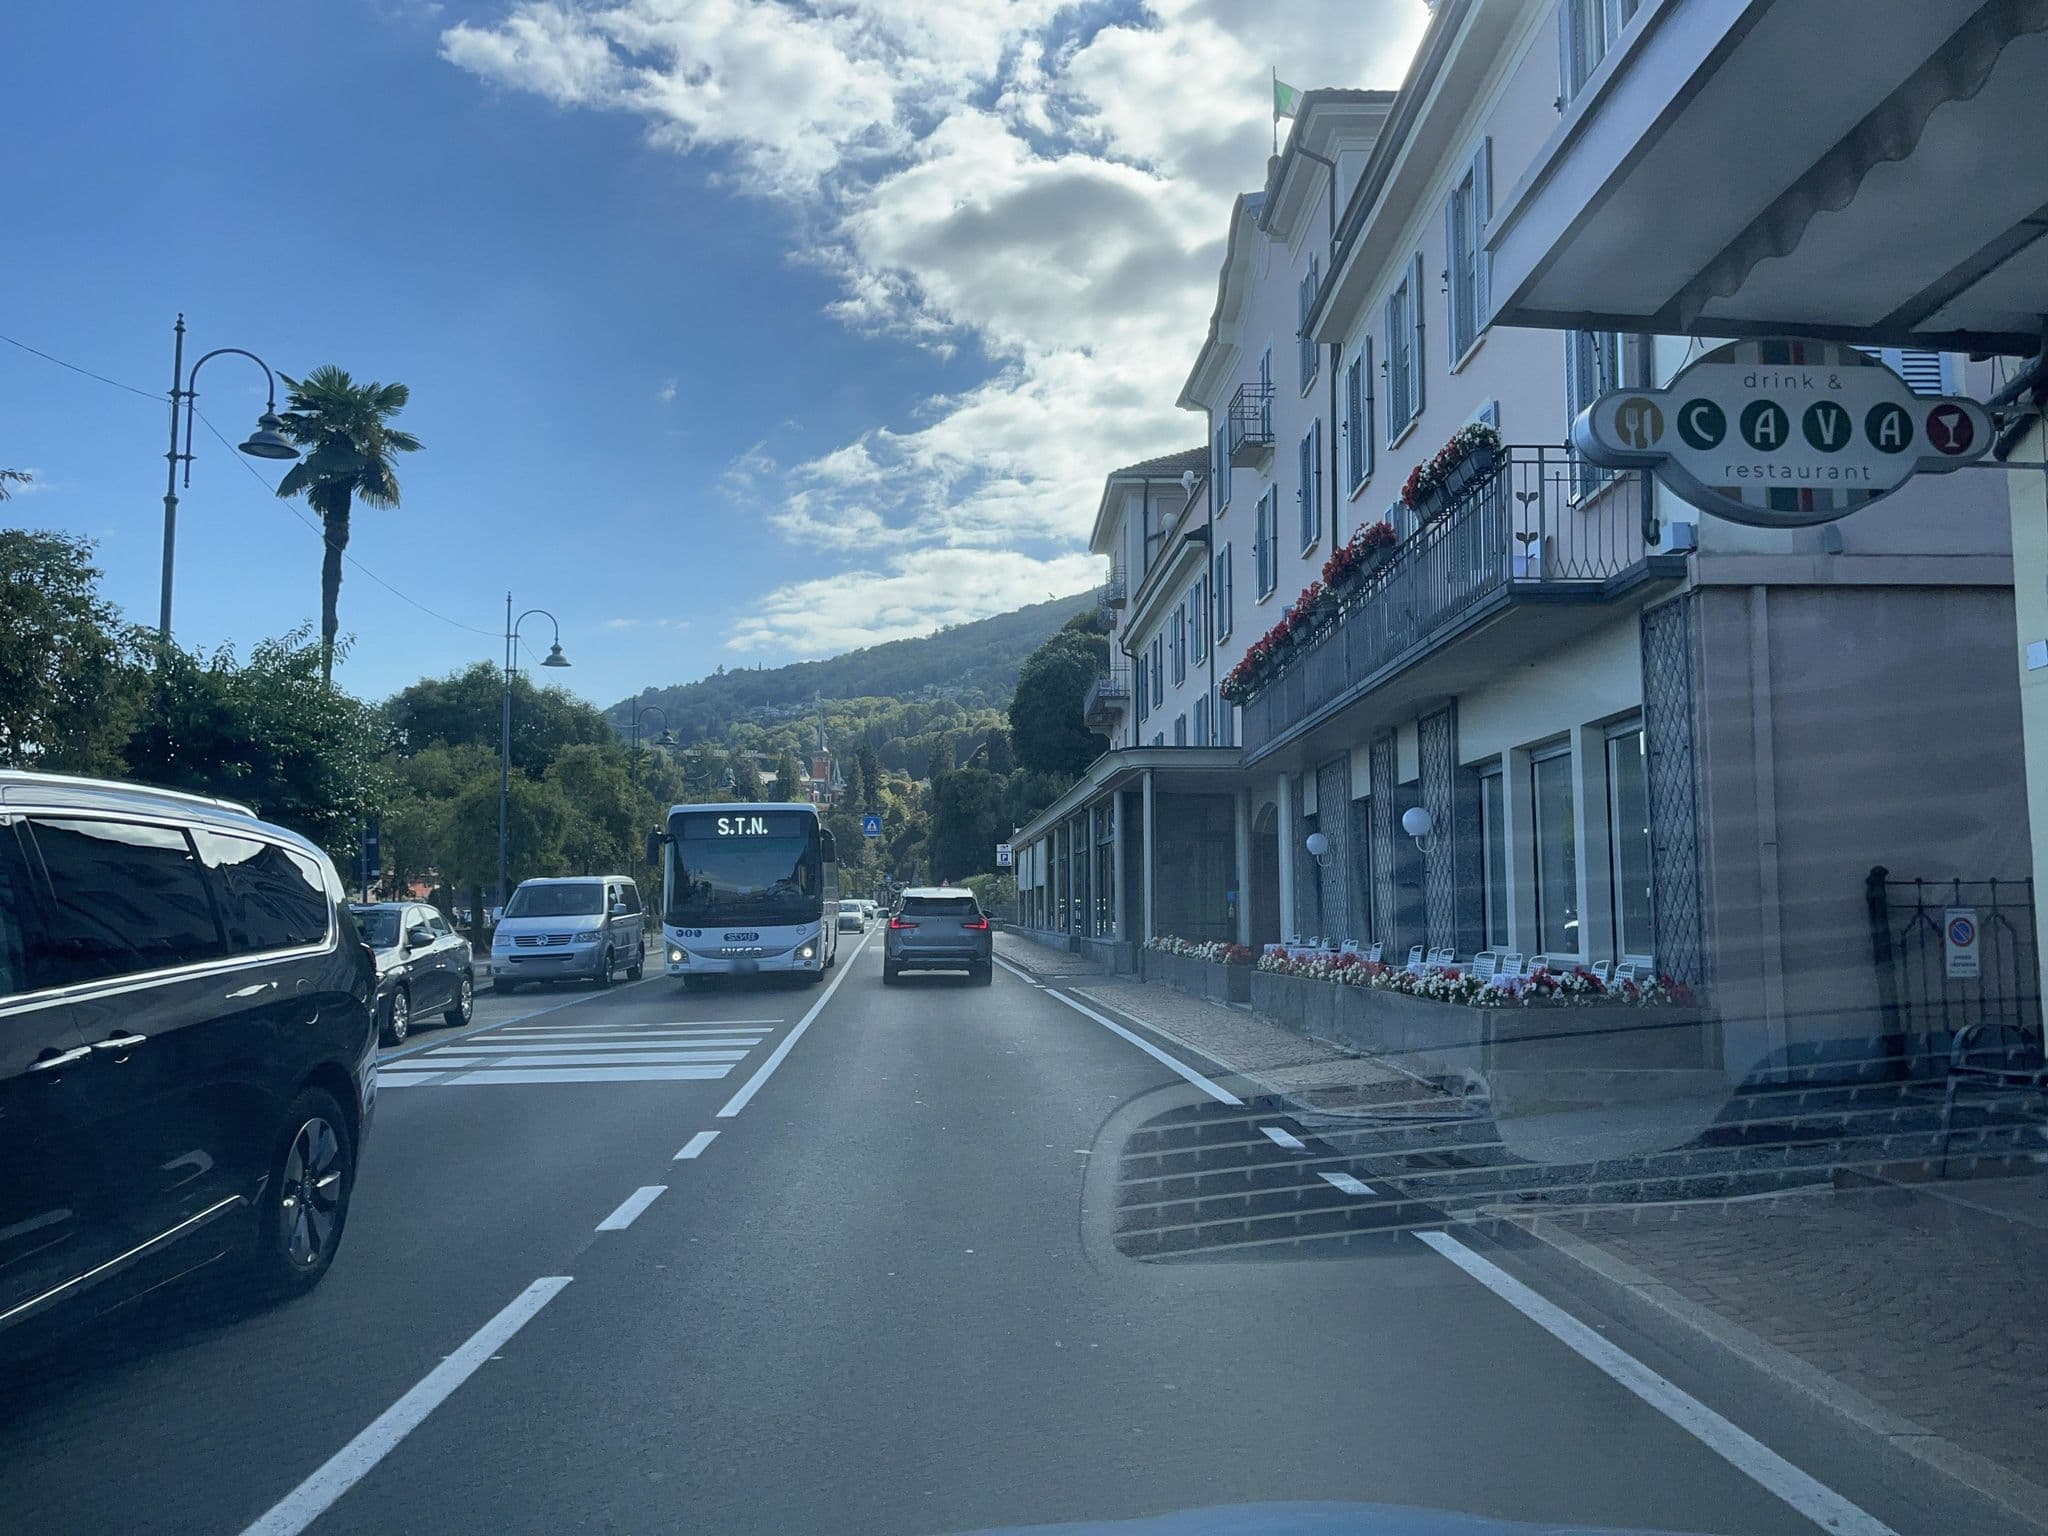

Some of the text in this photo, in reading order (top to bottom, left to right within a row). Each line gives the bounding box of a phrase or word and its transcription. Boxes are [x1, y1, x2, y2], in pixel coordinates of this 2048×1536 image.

[1744, 372, 1842, 390] drink &
[1690, 406, 1900, 446] CAVA
[1725, 463, 1872, 480] restaurant
[717, 817, 768, 835] S.T.N.
